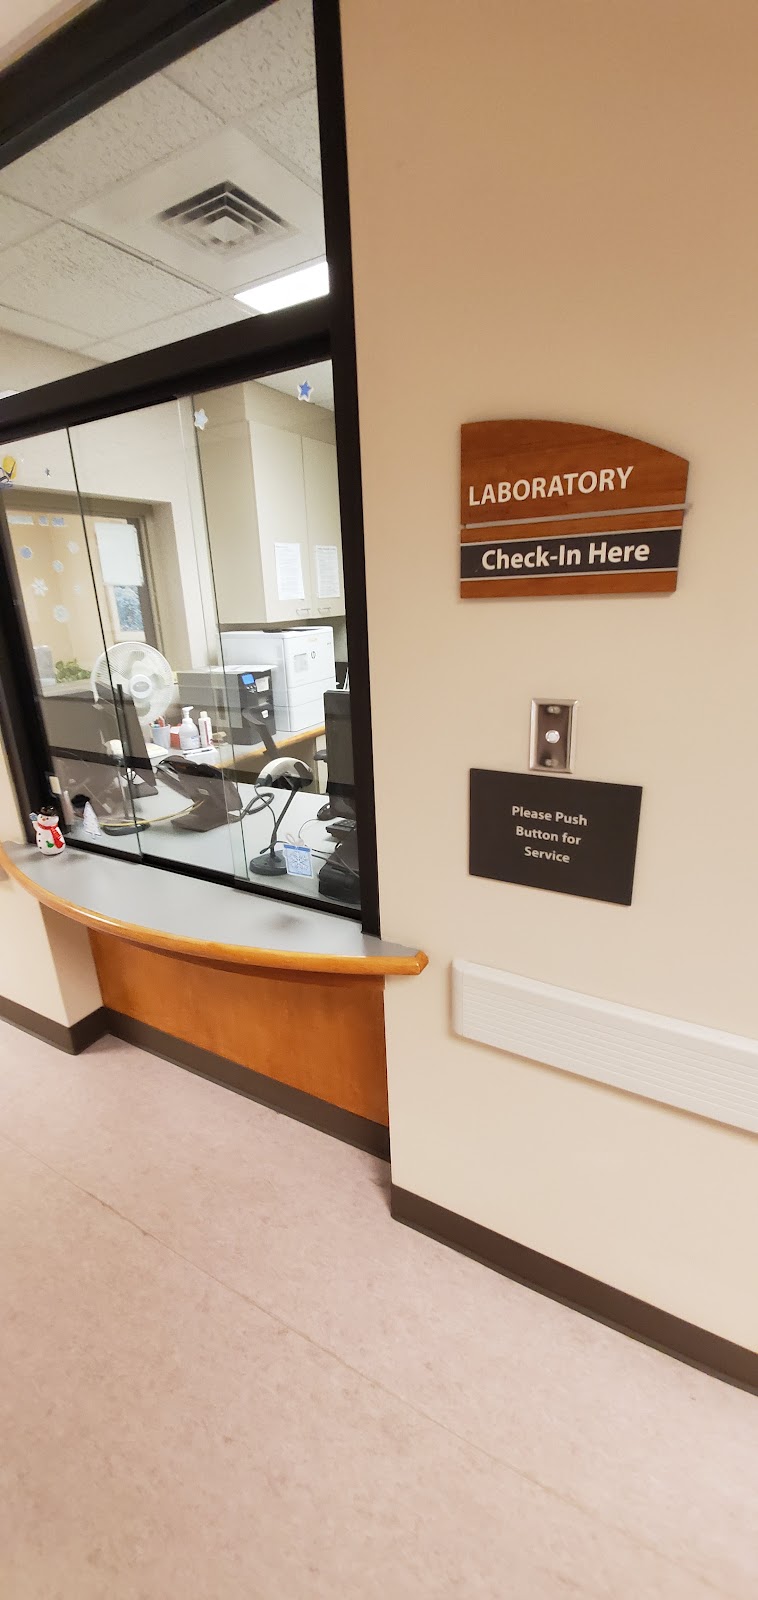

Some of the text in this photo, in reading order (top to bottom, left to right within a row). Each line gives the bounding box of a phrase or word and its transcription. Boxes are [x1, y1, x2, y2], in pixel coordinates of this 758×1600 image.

[469, 465, 634, 506] LABORATORY
[481, 541, 650, 570] Check-In Here
[511, 805, 588, 826] Please Push
[515, 825, 582, 846] Button for
[524, 846, 570, 863] Service
